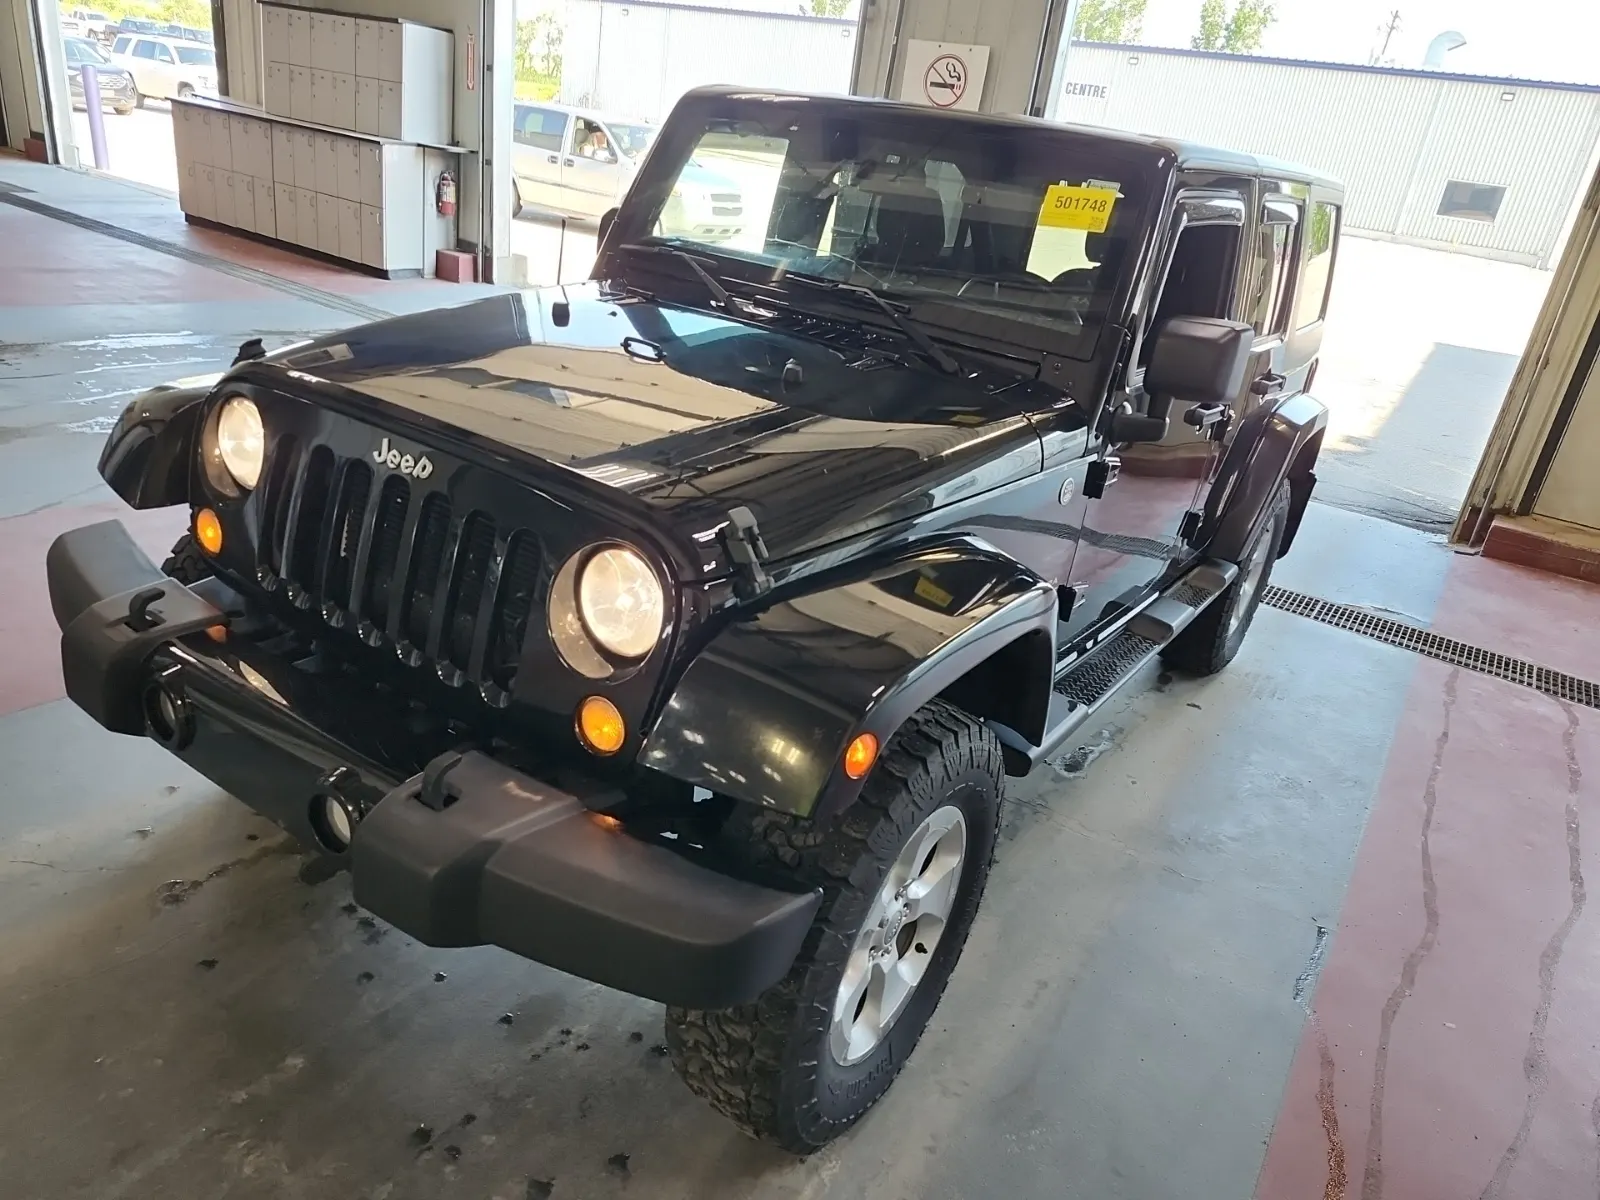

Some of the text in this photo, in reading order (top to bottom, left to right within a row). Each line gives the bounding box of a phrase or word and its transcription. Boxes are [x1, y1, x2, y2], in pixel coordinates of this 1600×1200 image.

[1065, 82, 1107, 99] CENTRE
[1054, 195, 1107, 213] 501748
[372, 437, 433, 479] Jeep
